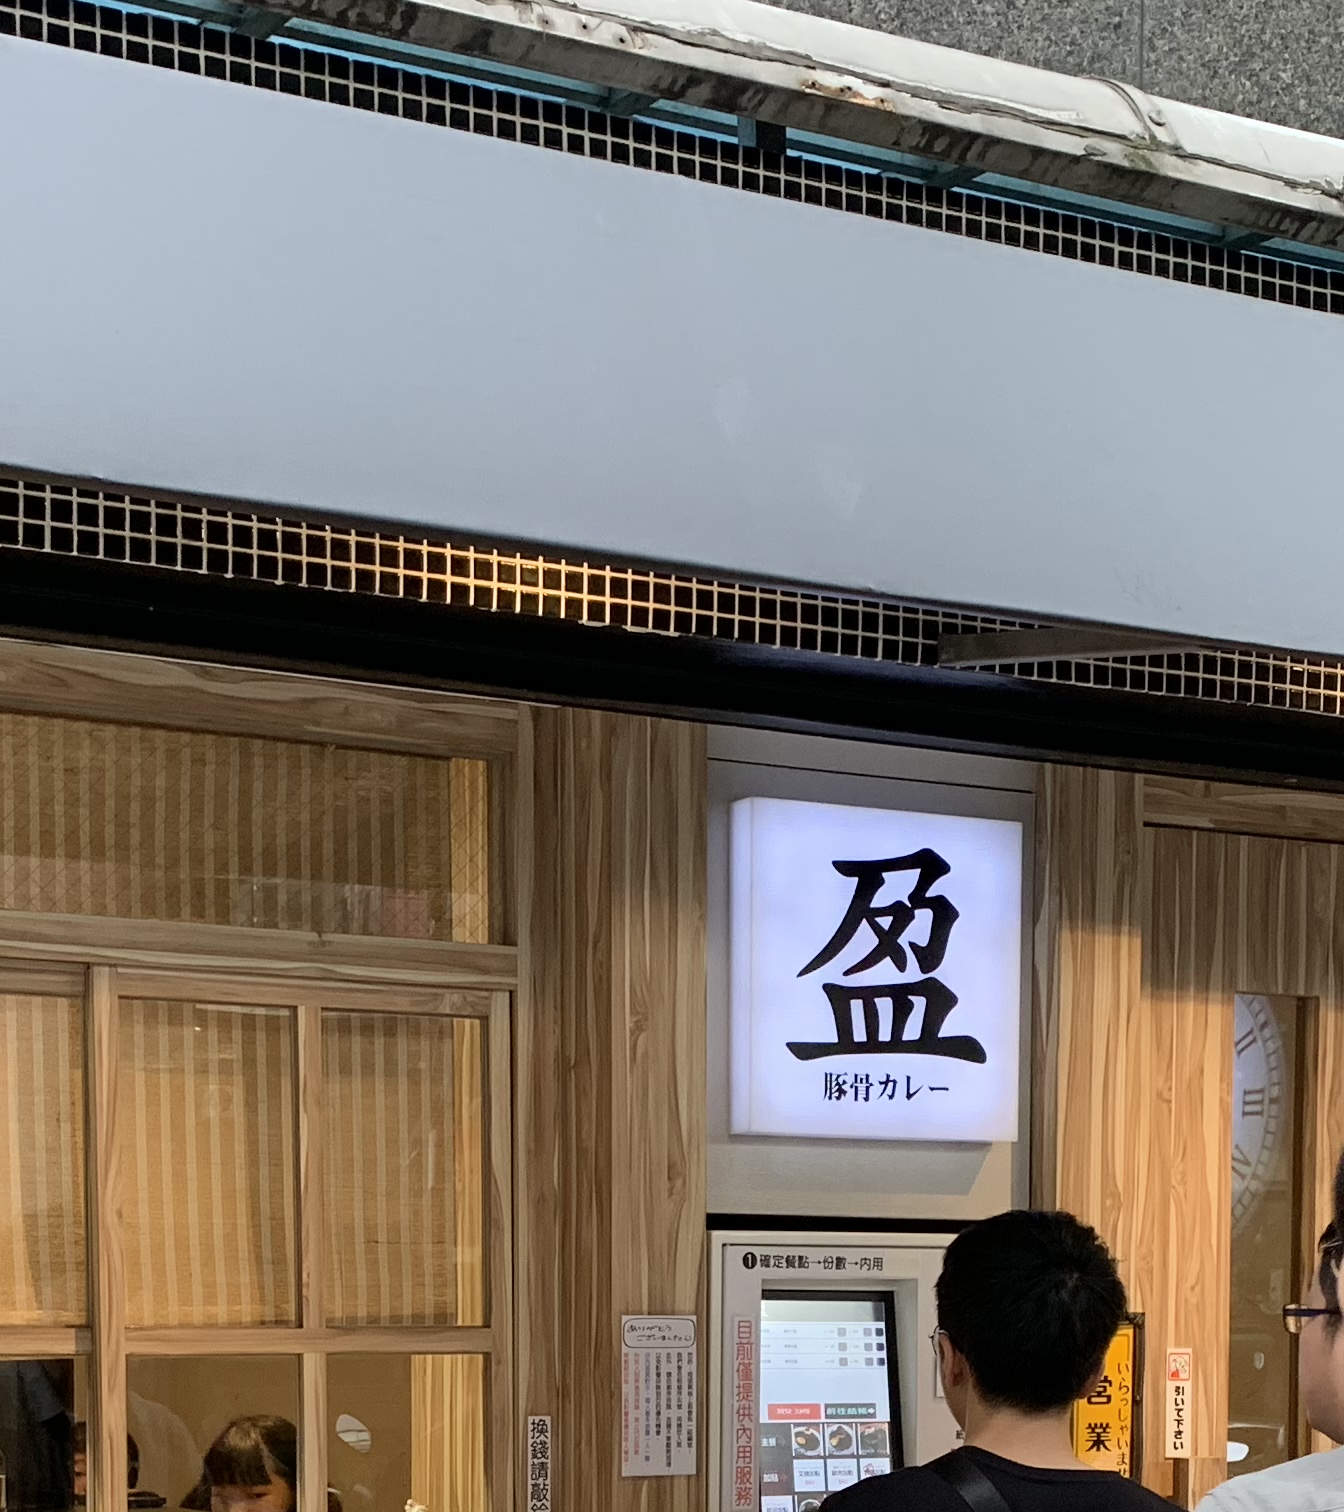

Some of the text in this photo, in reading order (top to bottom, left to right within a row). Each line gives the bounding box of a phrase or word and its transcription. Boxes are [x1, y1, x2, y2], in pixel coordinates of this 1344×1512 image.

[786, 847, 987, 1064] 盈
[822, 1071, 950, 1103] 豚骨カレー
[733, 1319, 754, 1507] 目前僅提供內用服務
[1172, 1385, 1186, 1451] 引いて下さい
